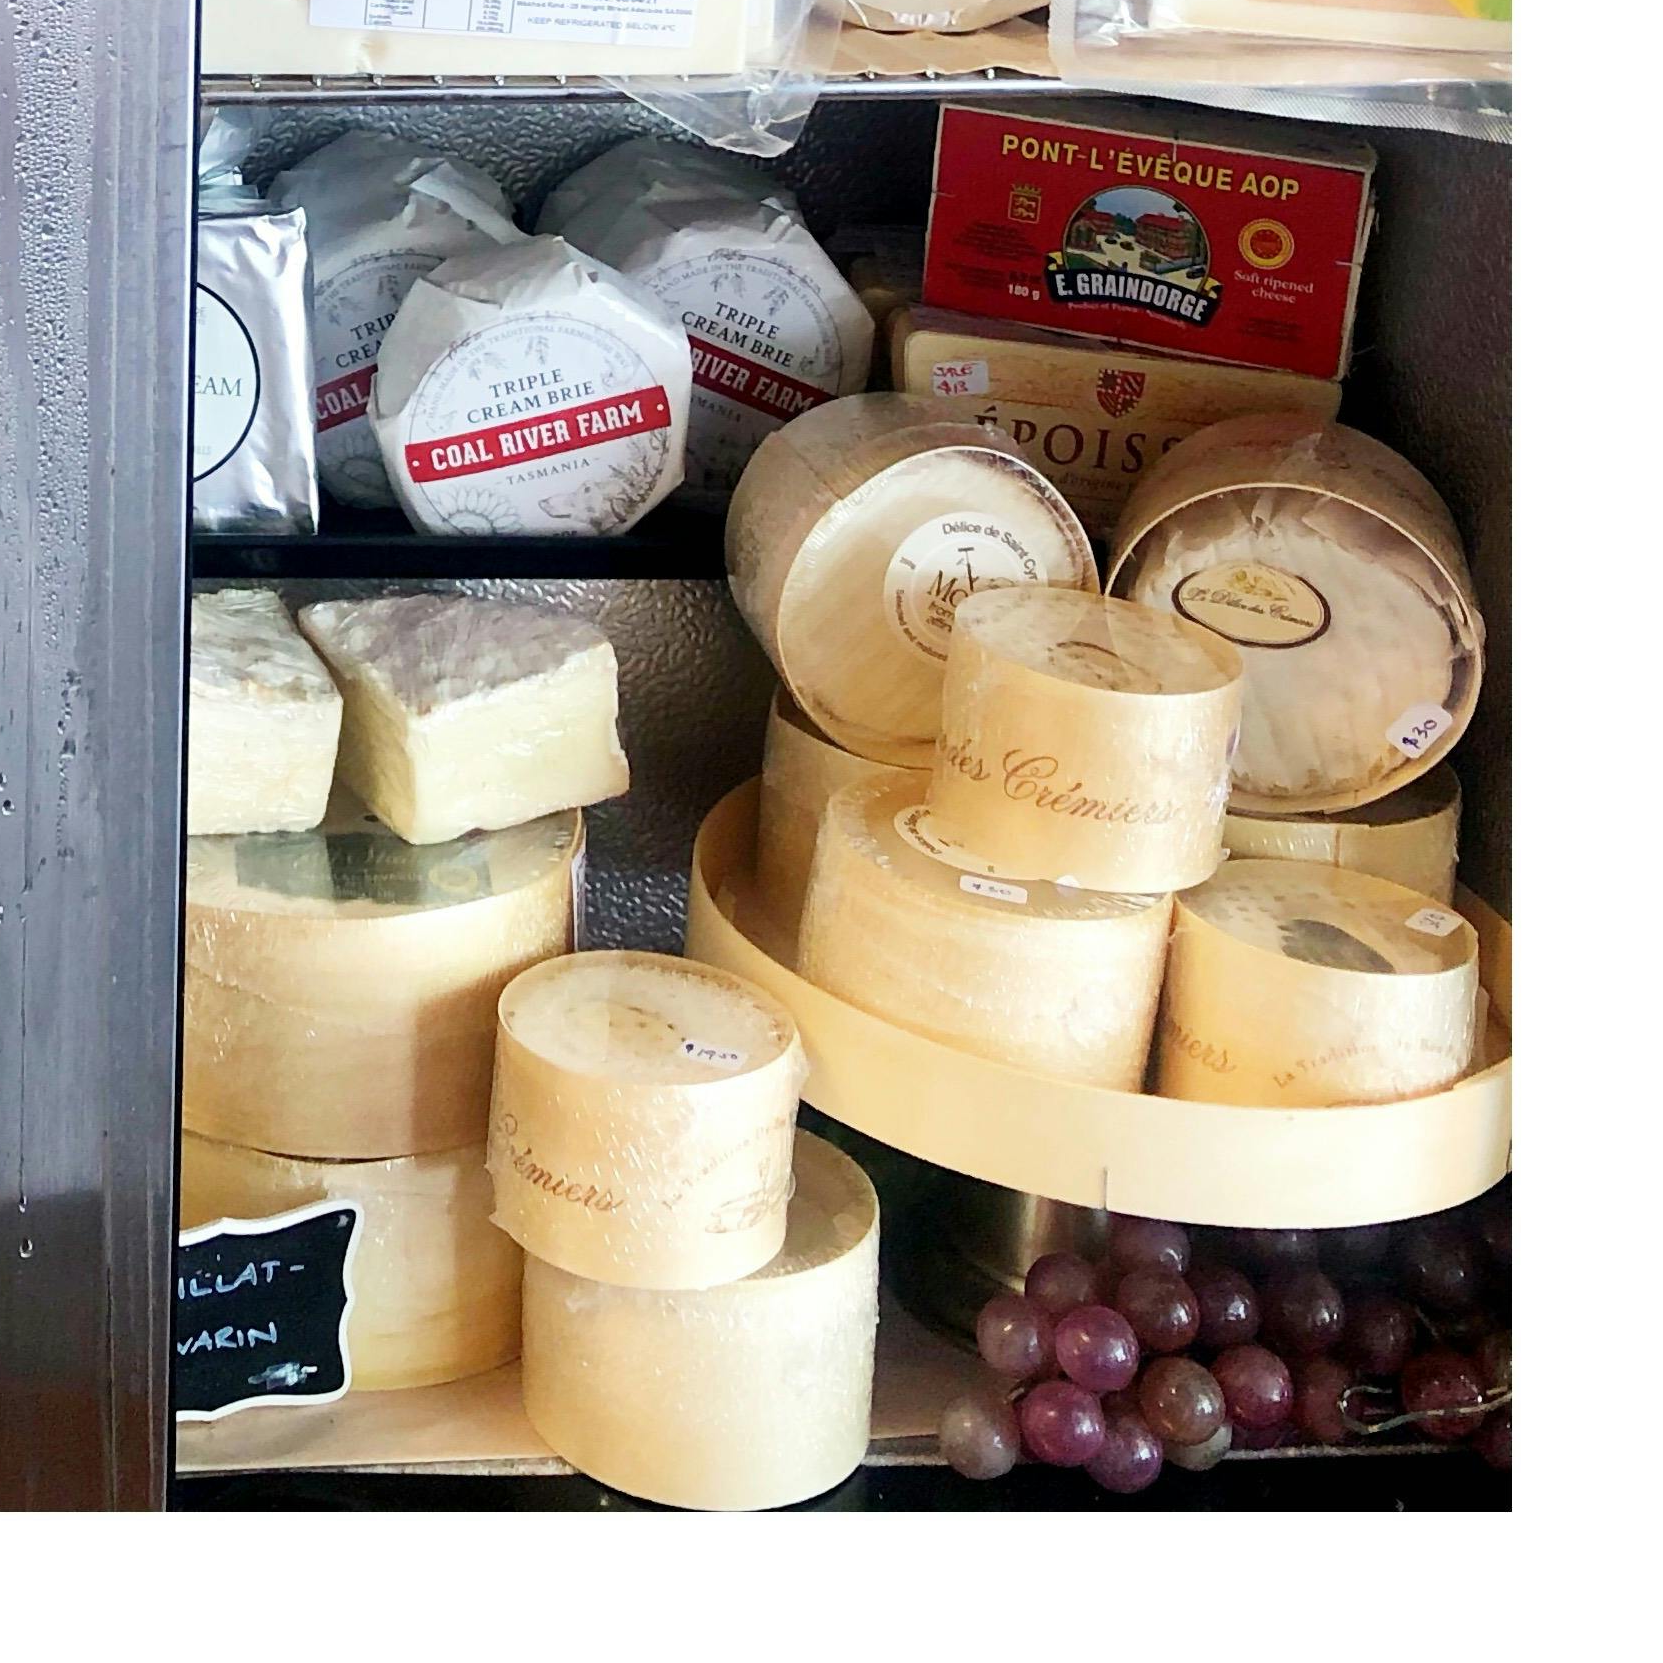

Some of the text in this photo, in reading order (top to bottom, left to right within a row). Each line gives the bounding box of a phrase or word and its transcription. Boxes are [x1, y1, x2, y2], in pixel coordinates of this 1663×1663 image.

[1002, 134, 1300, 201] PONT-L'ÉVÊQUE AOP
[1056, 272, 1209, 322] E. GRAINDORGE
[1233, 268, 1314, 295] Soft ripened
[1251, 287, 1297, 304] cheese
[681, 311, 794, 368] CREAM BRIE
[715, 300, 781, 341] TRIPLE
[466, 380, 595, 425] CREAM BRIE
[488, 368, 564, 399] TRIPLE
[691, 347, 815, 413] RIVER FARM
[430, 399, 644, 472] COAL RIVER FARM
[505, 457, 591, 486] TASMANIA
[942, 521, 1038, 580] Délice de Saint Cyr
[1400, 717, 1439, 751] $30
[1002, 748, 1179, 825] Crémiers
[177, 1321, 278, 1355] VARIN
